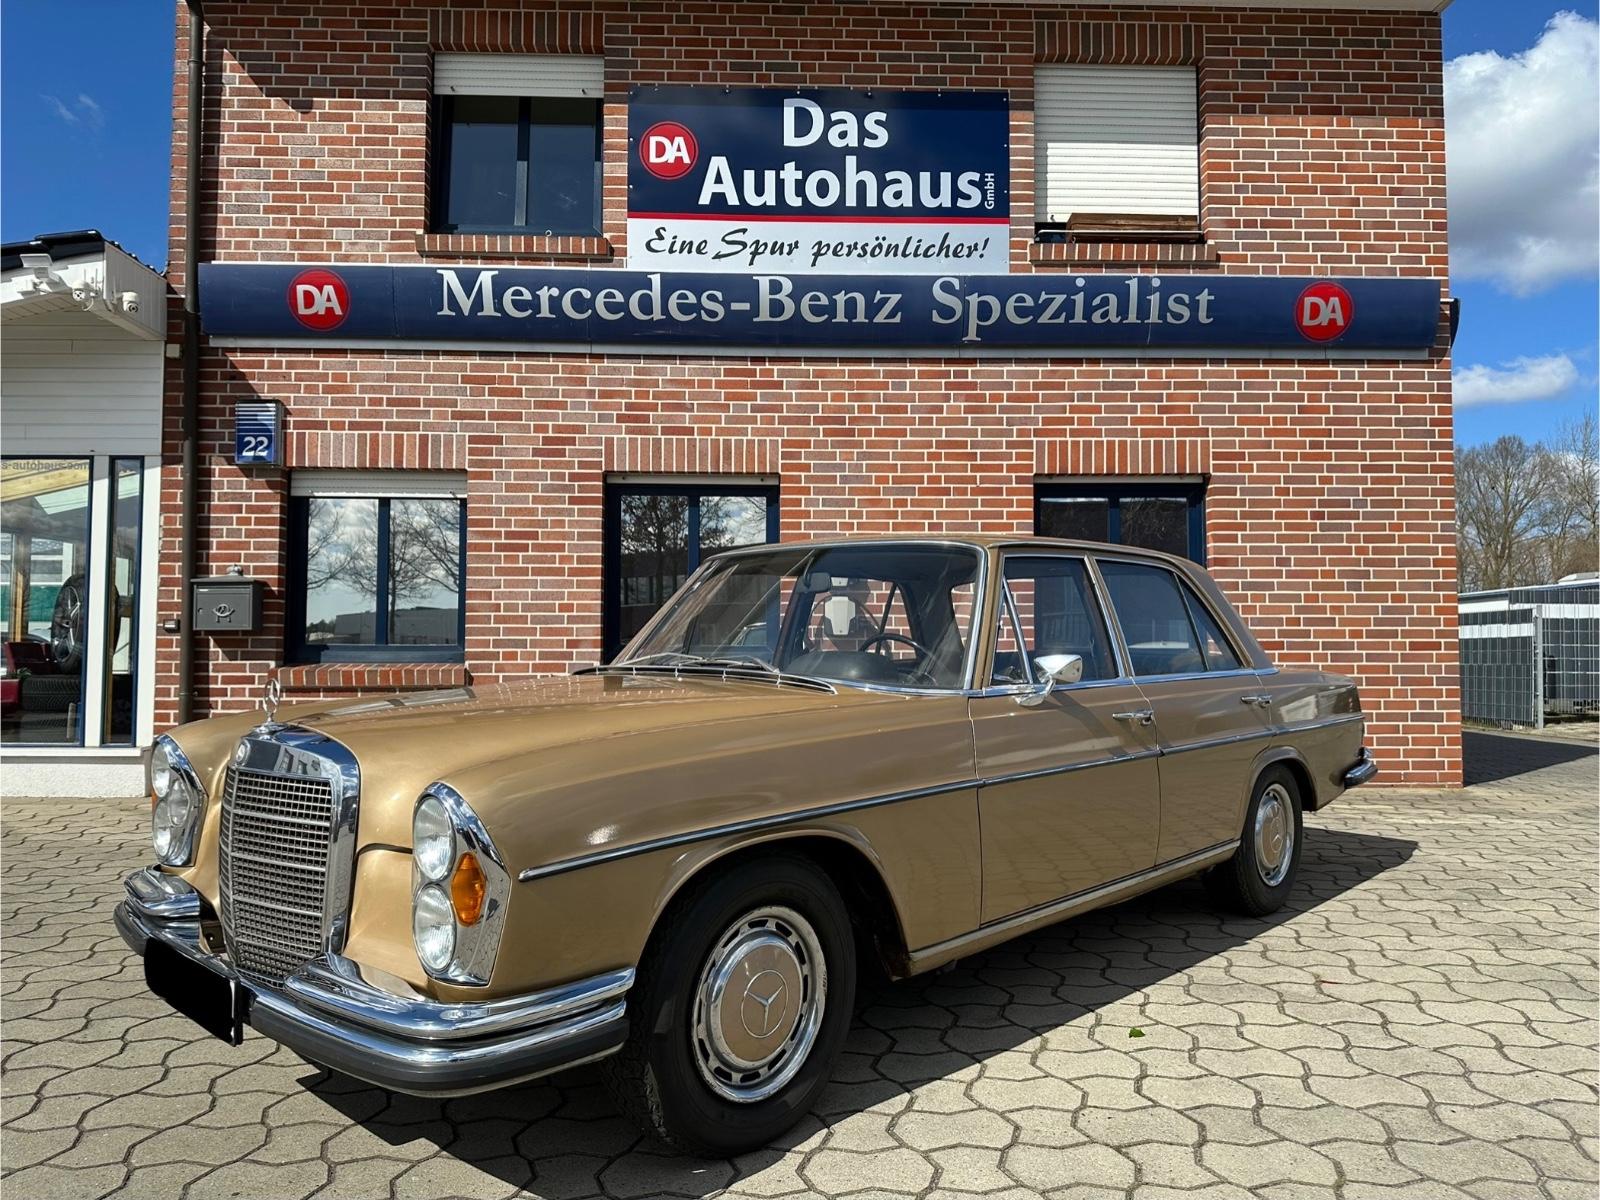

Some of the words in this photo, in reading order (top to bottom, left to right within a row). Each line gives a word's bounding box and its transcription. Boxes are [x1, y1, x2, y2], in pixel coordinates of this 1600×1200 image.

[783, 98, 889, 148] Das
[648, 135, 692, 165] DA
[698, 155, 982, 208] Autohaus
[984, 172, 995, 210] GmbH
[645, 226, 708, 256] Eine
[711, 228, 800, 267] Spur
[811, 232, 990, 267] persönlicher!
[295, 283, 344, 317] DA
[436, 269, 902, 324] Mercedes-Benz
[931, 277, 1214, 342] Spezialist
[1301, 296, 1345, 327] DA
[242, 436, 269, 457] 22
